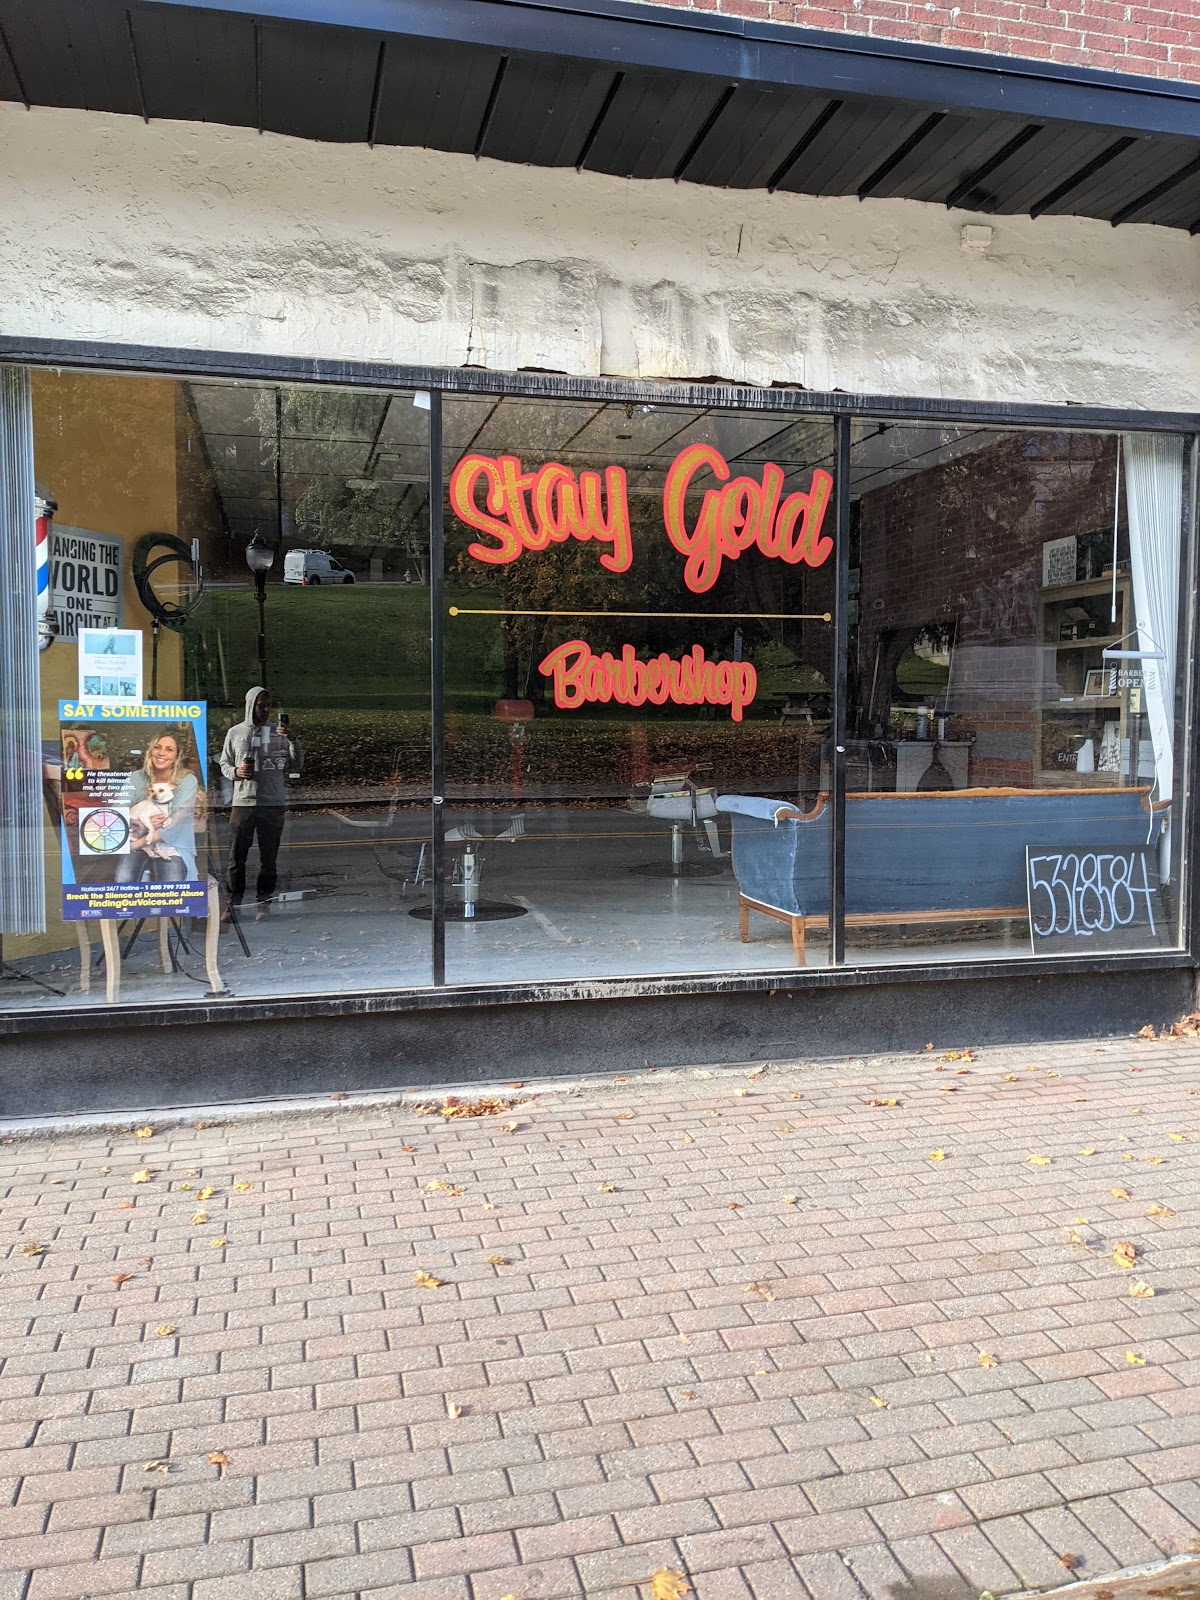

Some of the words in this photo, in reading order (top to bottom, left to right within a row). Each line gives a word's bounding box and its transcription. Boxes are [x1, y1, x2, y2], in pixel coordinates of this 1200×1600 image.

[450, 454, 633, 573] Stay
[663, 443, 834, 593] Gold
[53, 536, 96, 562] ANGING
[99, 544, 119, 566] THE
[66, 596, 93, 611] ONE
[53, 610, 101, 636] AIRCUT
[538, 640, 757, 721] Barbershop
[63, 704, 95, 717] SAY
[101, 705, 202, 718] SOMETHING
[1058, 752, 1077, 763] ENTR
[89, 898, 184, 908] FindingOurVoices.net
